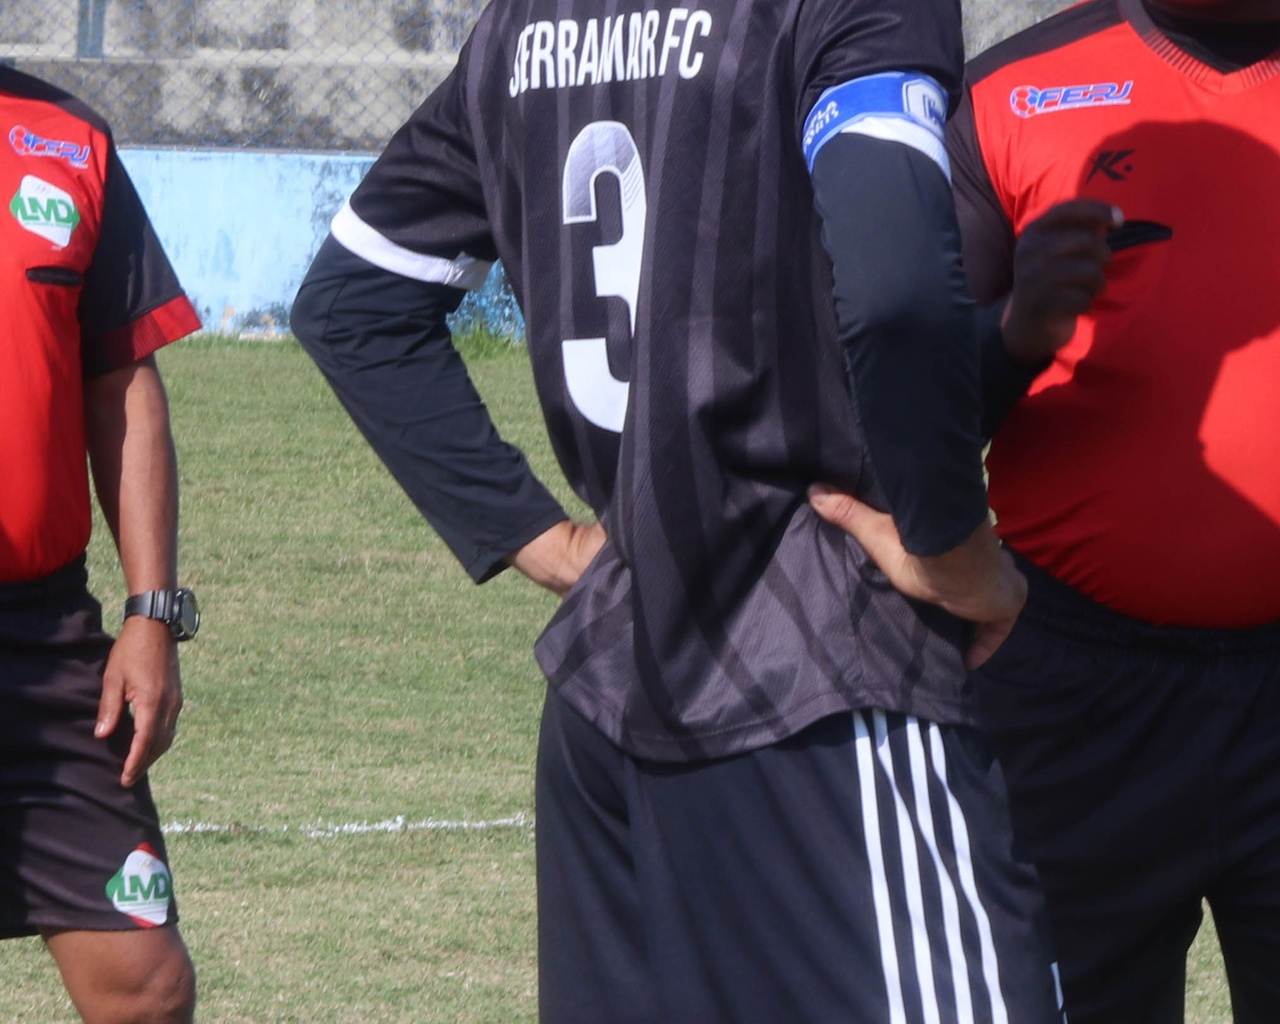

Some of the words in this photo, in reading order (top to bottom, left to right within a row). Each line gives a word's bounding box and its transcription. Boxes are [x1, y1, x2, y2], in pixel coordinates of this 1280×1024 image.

[509, 9, 660, 98] SERRAMAR
[658, 7, 712, 79] FC
[1037, 80, 1134, 113] FERJ
[18, 195, 74, 224] LMD
[561, 120, 647, 434] 3
[116, 872, 170, 903] LMD
